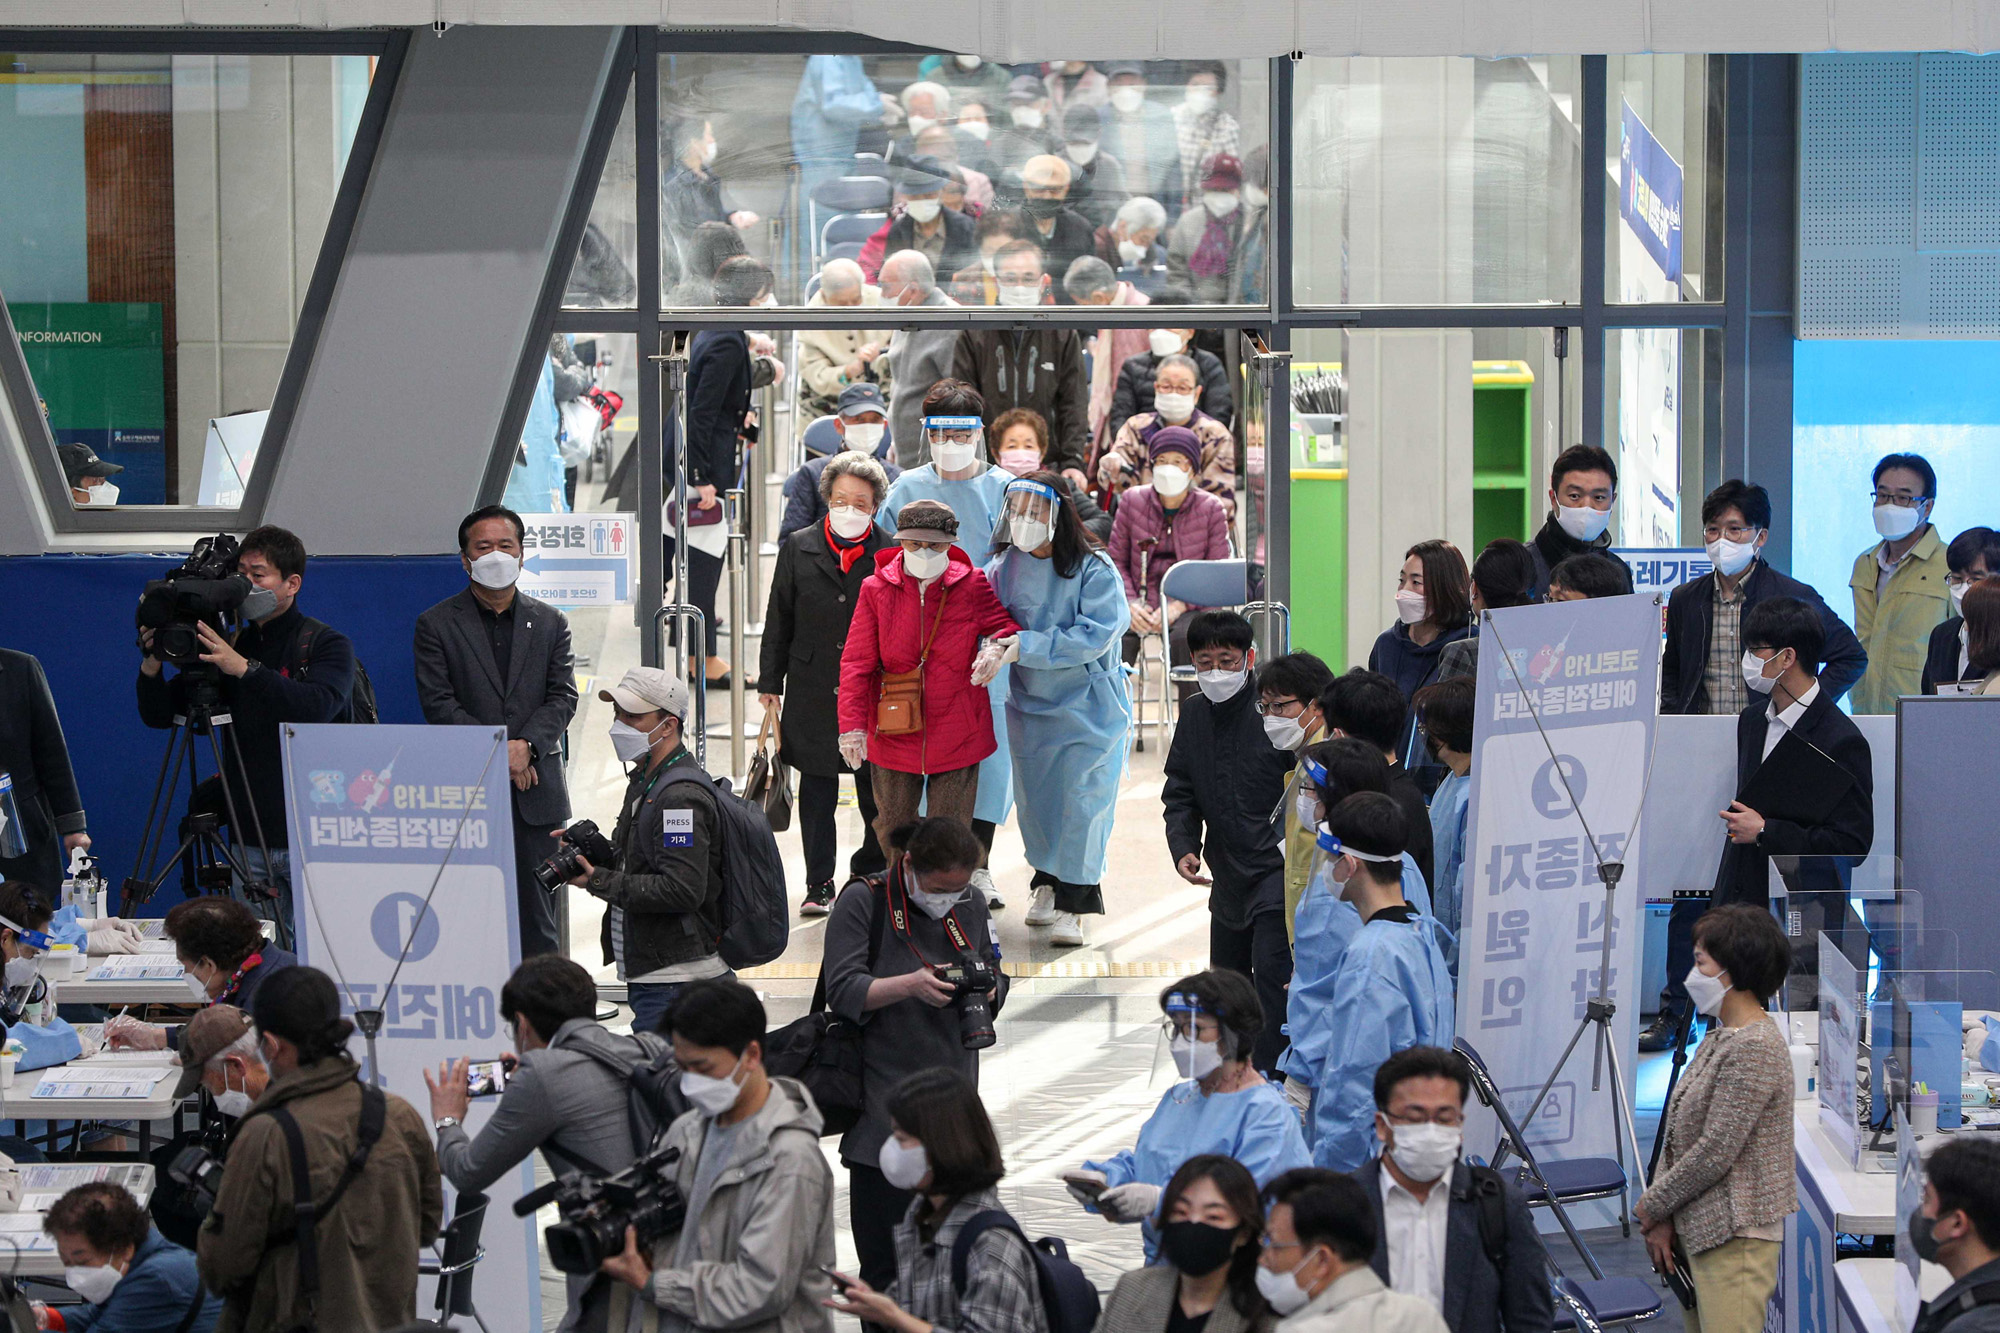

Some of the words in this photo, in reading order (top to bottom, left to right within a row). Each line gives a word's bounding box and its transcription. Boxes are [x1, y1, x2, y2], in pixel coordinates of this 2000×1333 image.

[17, 331, 102, 343] NFORMATION
[1627, 560, 1713, 586] 레기통
[666, 818, 690, 826] PRESS
[670, 835, 687, 845] 기자
[894, 909, 905, 930] EOS
[946, 917, 966, 947] Canon
